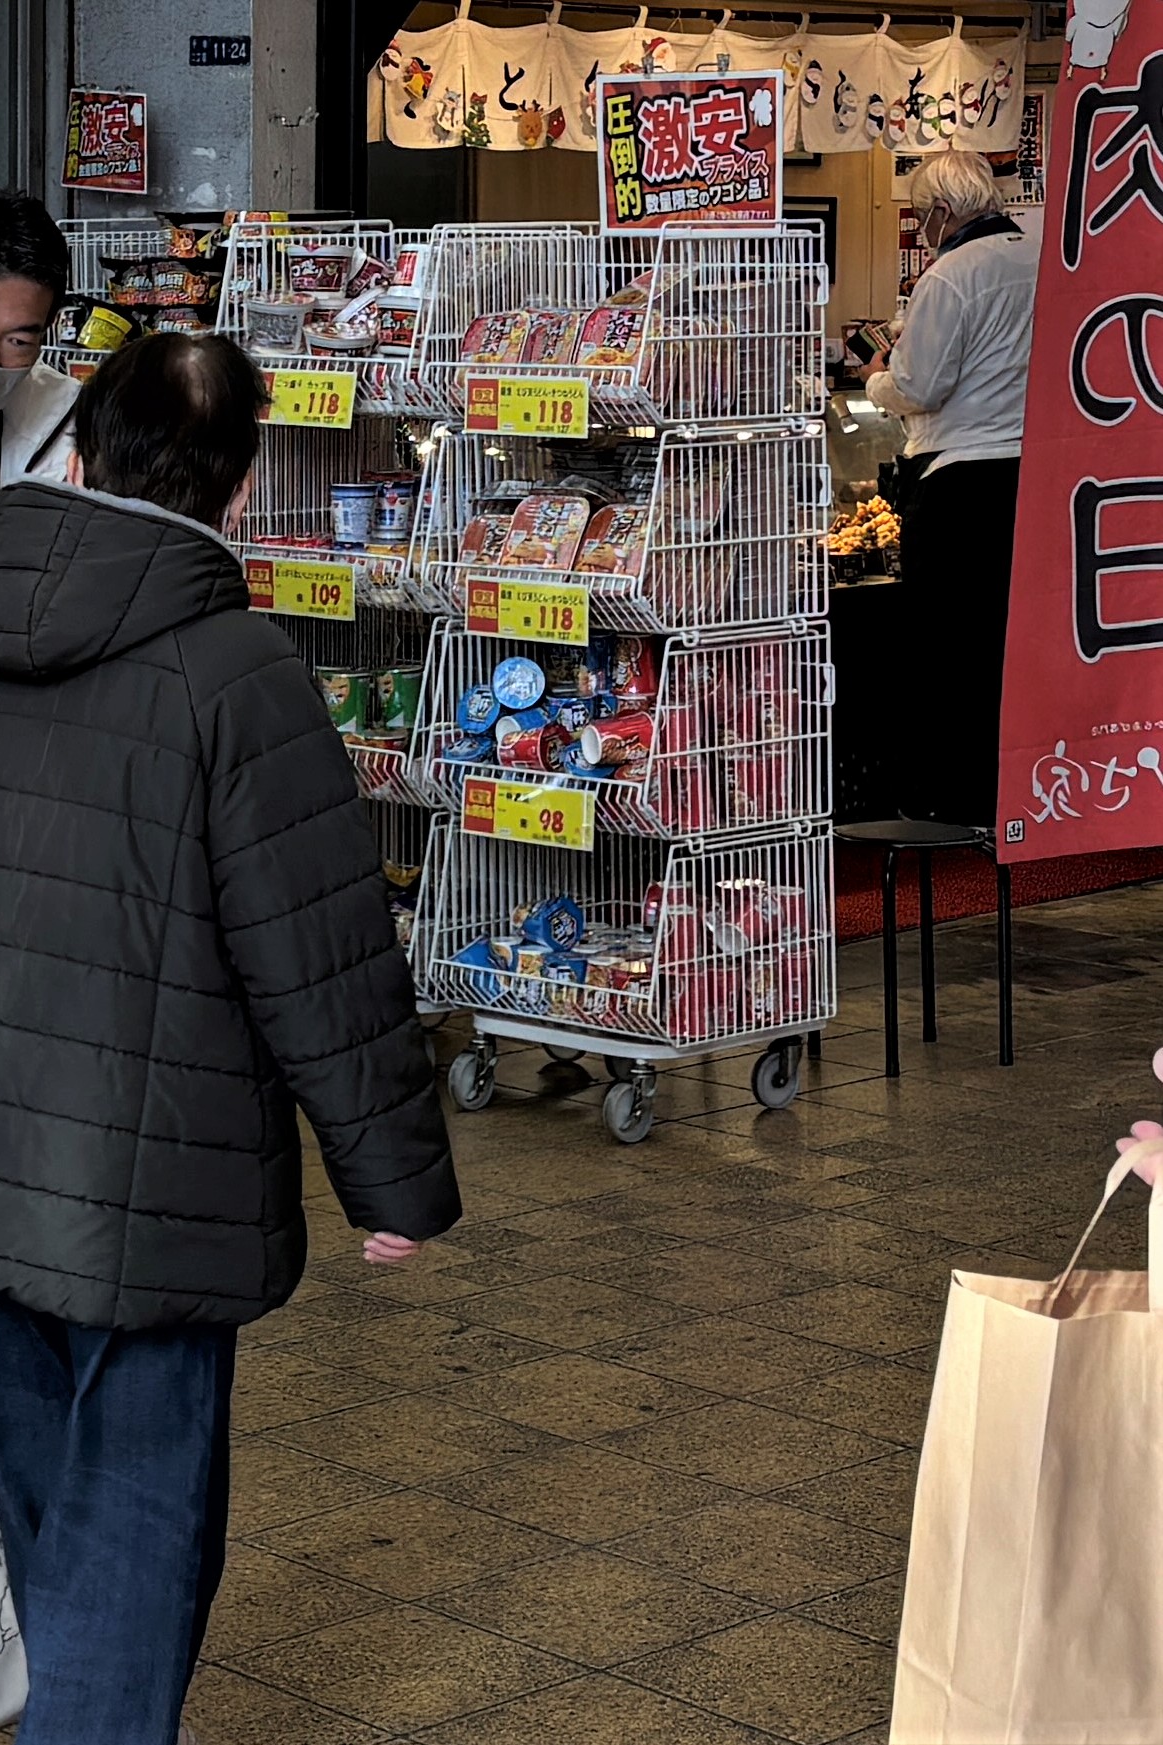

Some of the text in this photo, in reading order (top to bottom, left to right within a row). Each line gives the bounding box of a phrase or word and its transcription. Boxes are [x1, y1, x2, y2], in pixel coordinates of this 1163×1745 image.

[638, 89, 746, 183] 激安
[607, 95, 642, 218] 圧倒的
[703, 150, 770, 185] プライス
[308, 392, 340, 415] 118
[540, 400, 573, 424] 118
[311, 582, 340, 606] 109
[540, 605, 573, 630] 118
[540, 809, 564, 833] 98
